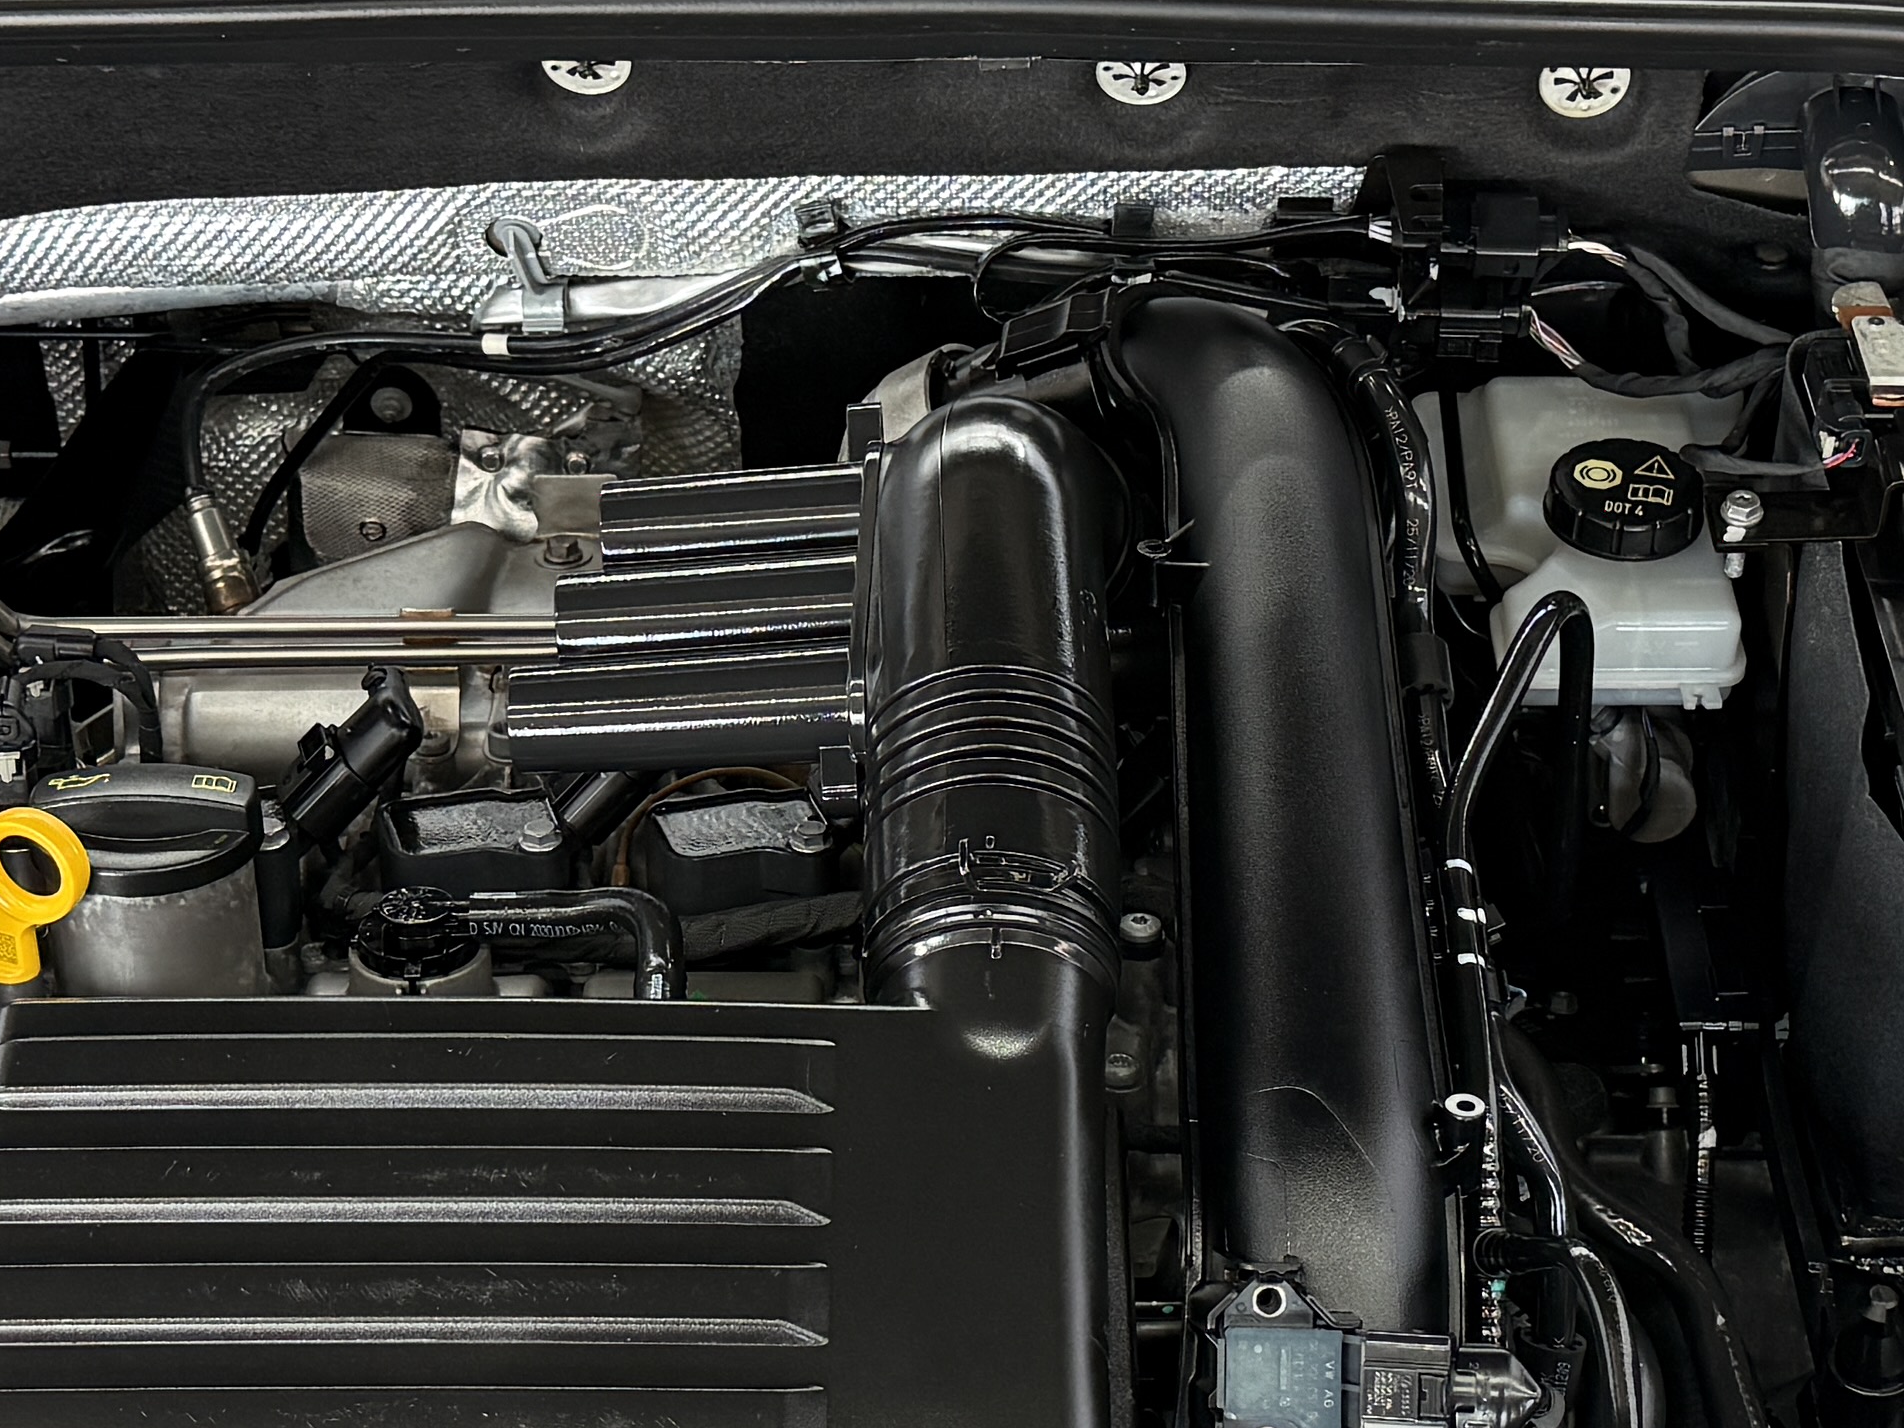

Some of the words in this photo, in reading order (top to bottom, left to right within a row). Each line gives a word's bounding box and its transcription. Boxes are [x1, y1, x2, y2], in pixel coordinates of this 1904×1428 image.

[1604, 500, 1632, 515] DOT
[1634, 504, 1643, 516] 4
[1324, 1360, 1336, 1380] VW
